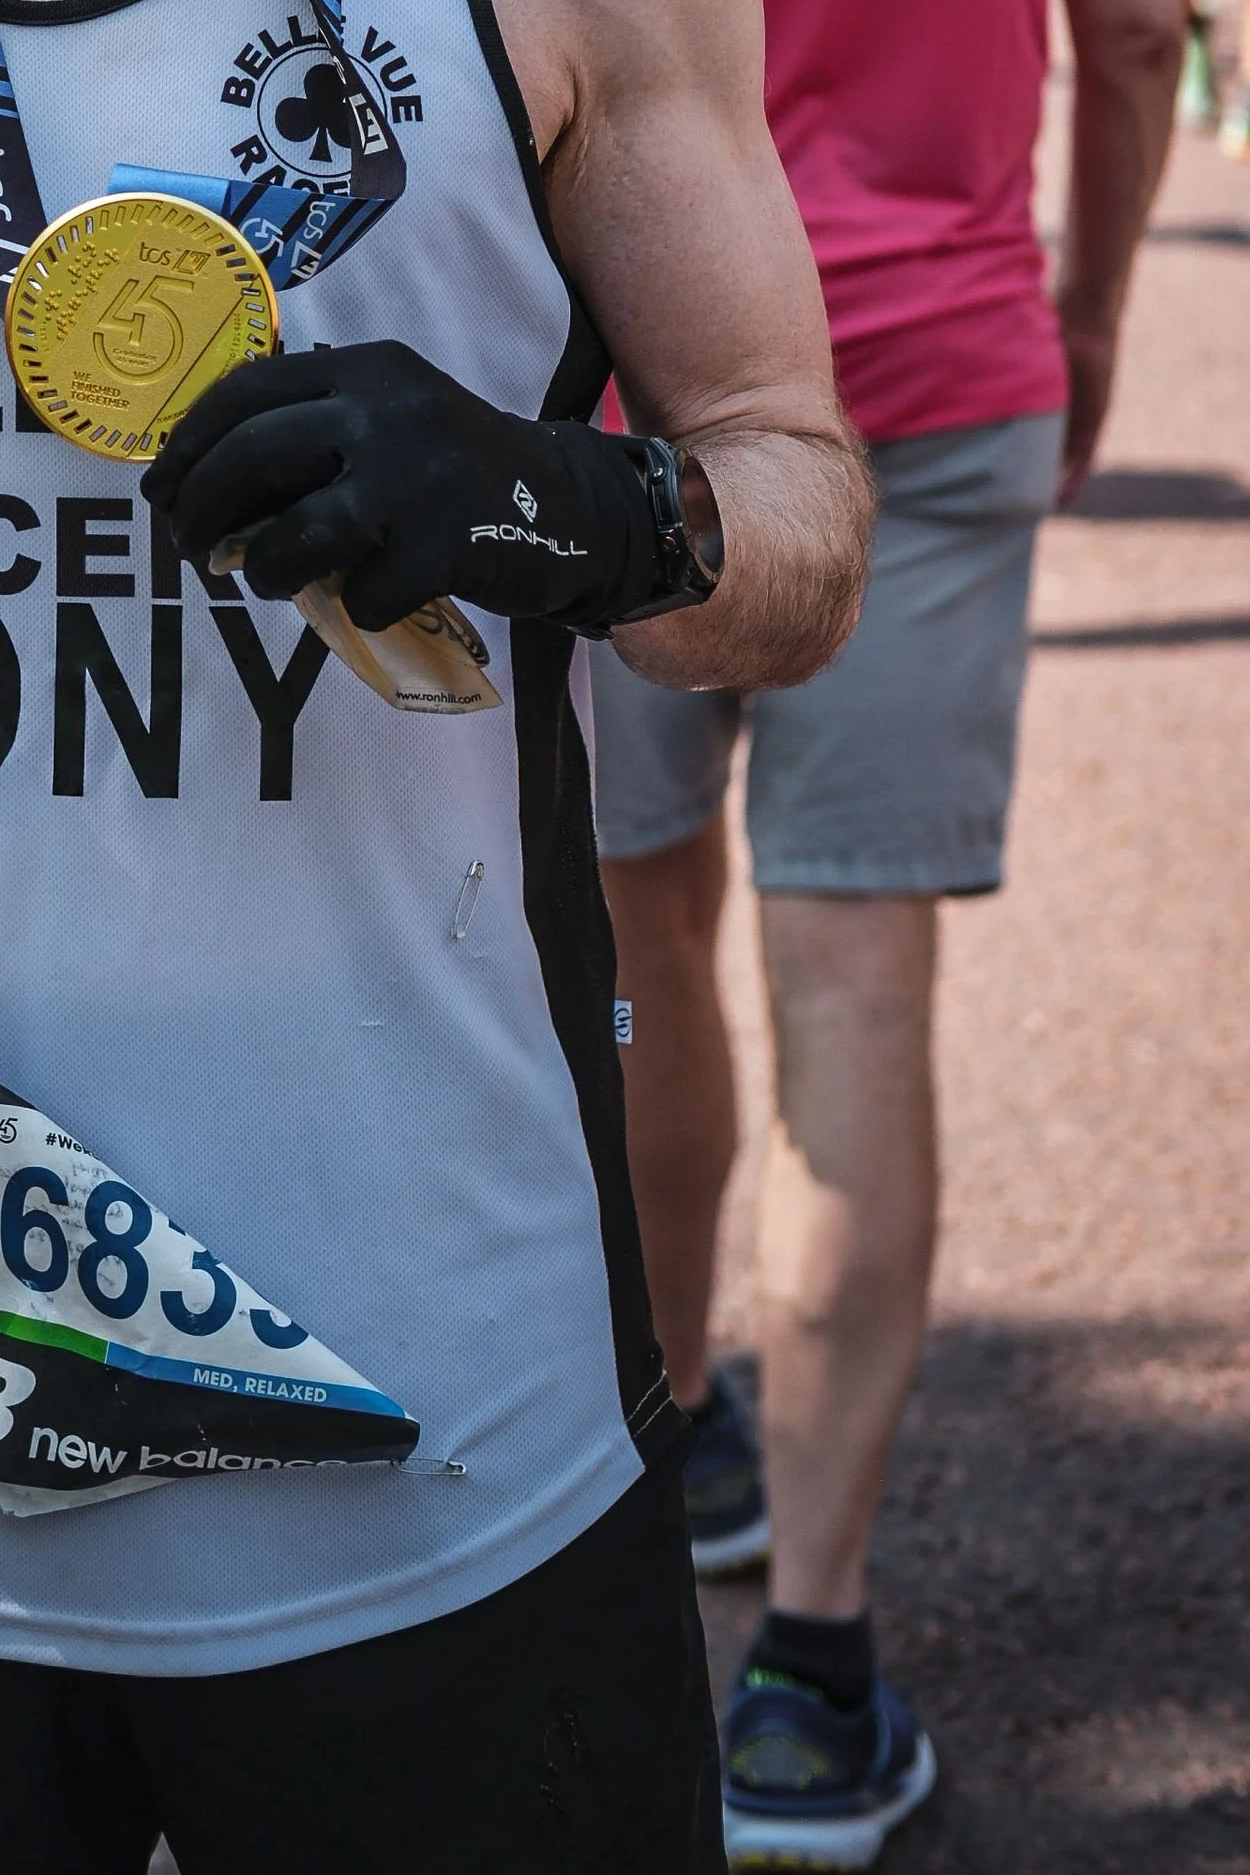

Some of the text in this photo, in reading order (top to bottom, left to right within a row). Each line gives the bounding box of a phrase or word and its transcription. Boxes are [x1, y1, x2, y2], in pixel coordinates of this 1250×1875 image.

[221, 14, 347, 108] BELL
[359, 25, 424, 124] VUE
[71, 381, 121, 398] FINISHED
[73, 370, 92, 383] WE
[71, 391, 130, 409] TOGETHER
[470, 524, 588, 557] RONHILL
[193, 1367, 327, 1403] MED, RELAXED
[28, 1426, 128, 1474] new
